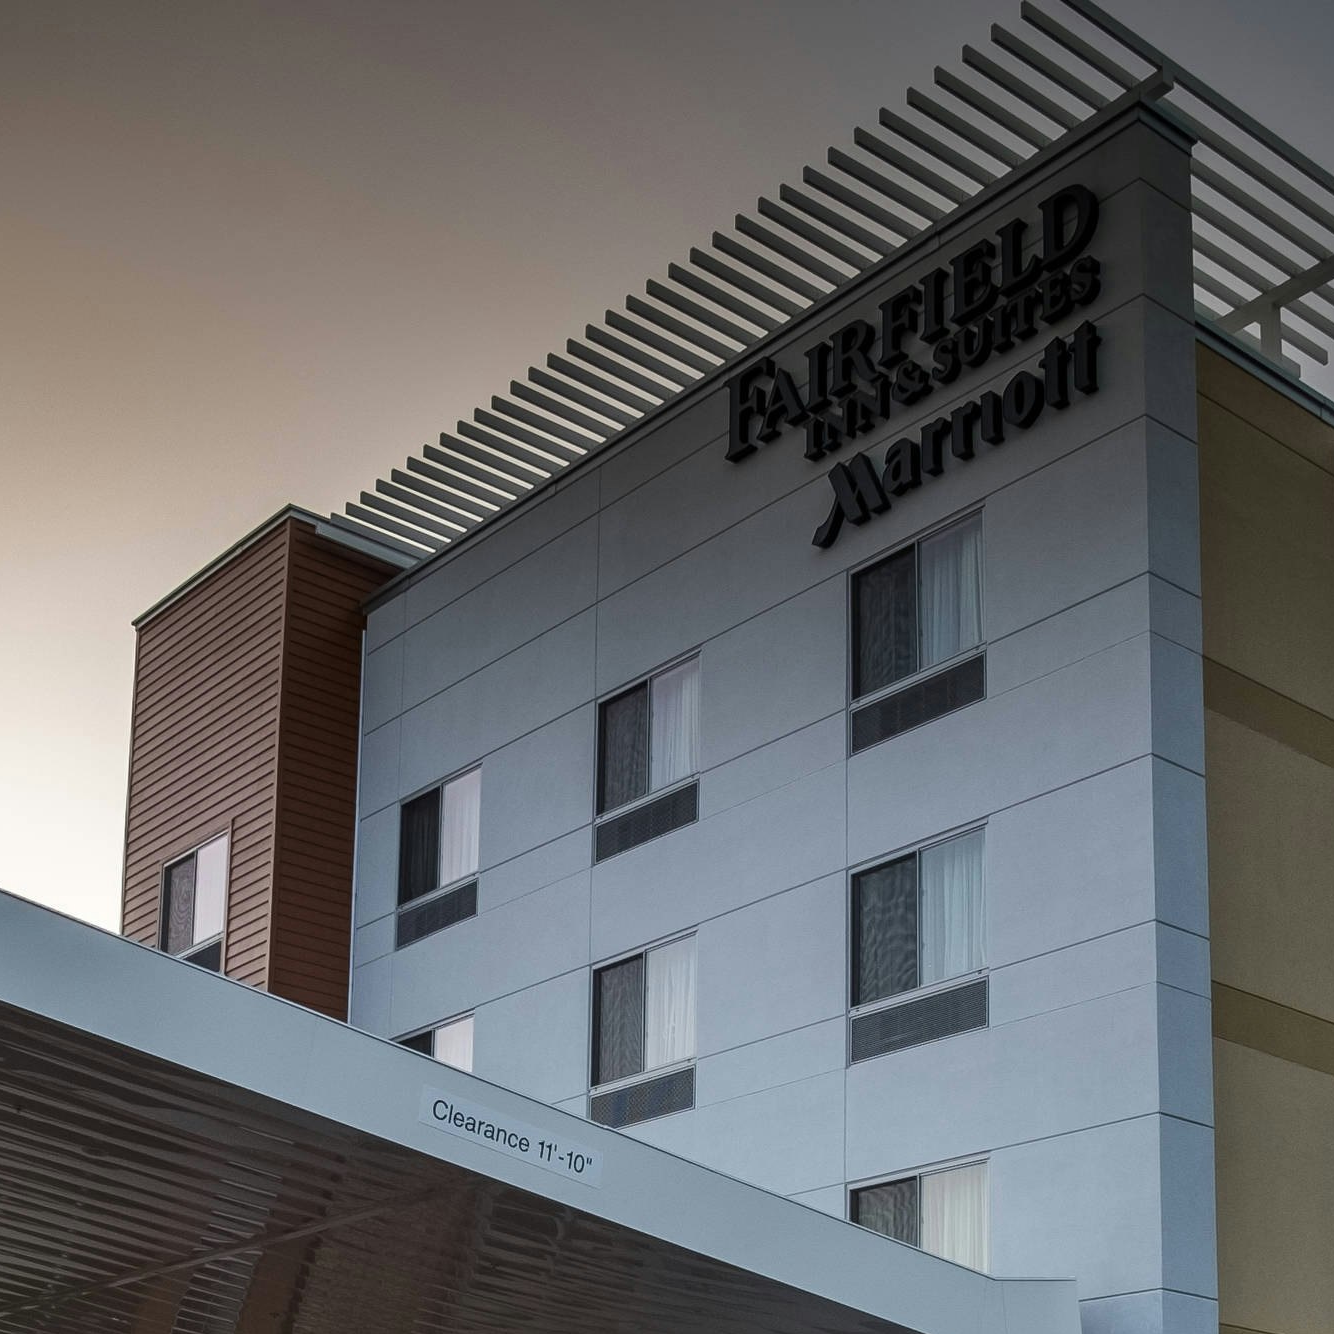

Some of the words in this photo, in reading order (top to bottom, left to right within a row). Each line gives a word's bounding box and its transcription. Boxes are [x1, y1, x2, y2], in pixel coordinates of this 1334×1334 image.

[724, 183, 1100, 464] FAIRFIELD
[804, 371, 891, 462] INN
[891, 361, 934, 406] &
[932, 255, 1102, 385] SUITES
[811, 320, 1103, 549] Marriott
[432, 1099, 530, 1153] Clearance
[538, 1140, 593, 1174] 11'-10"
